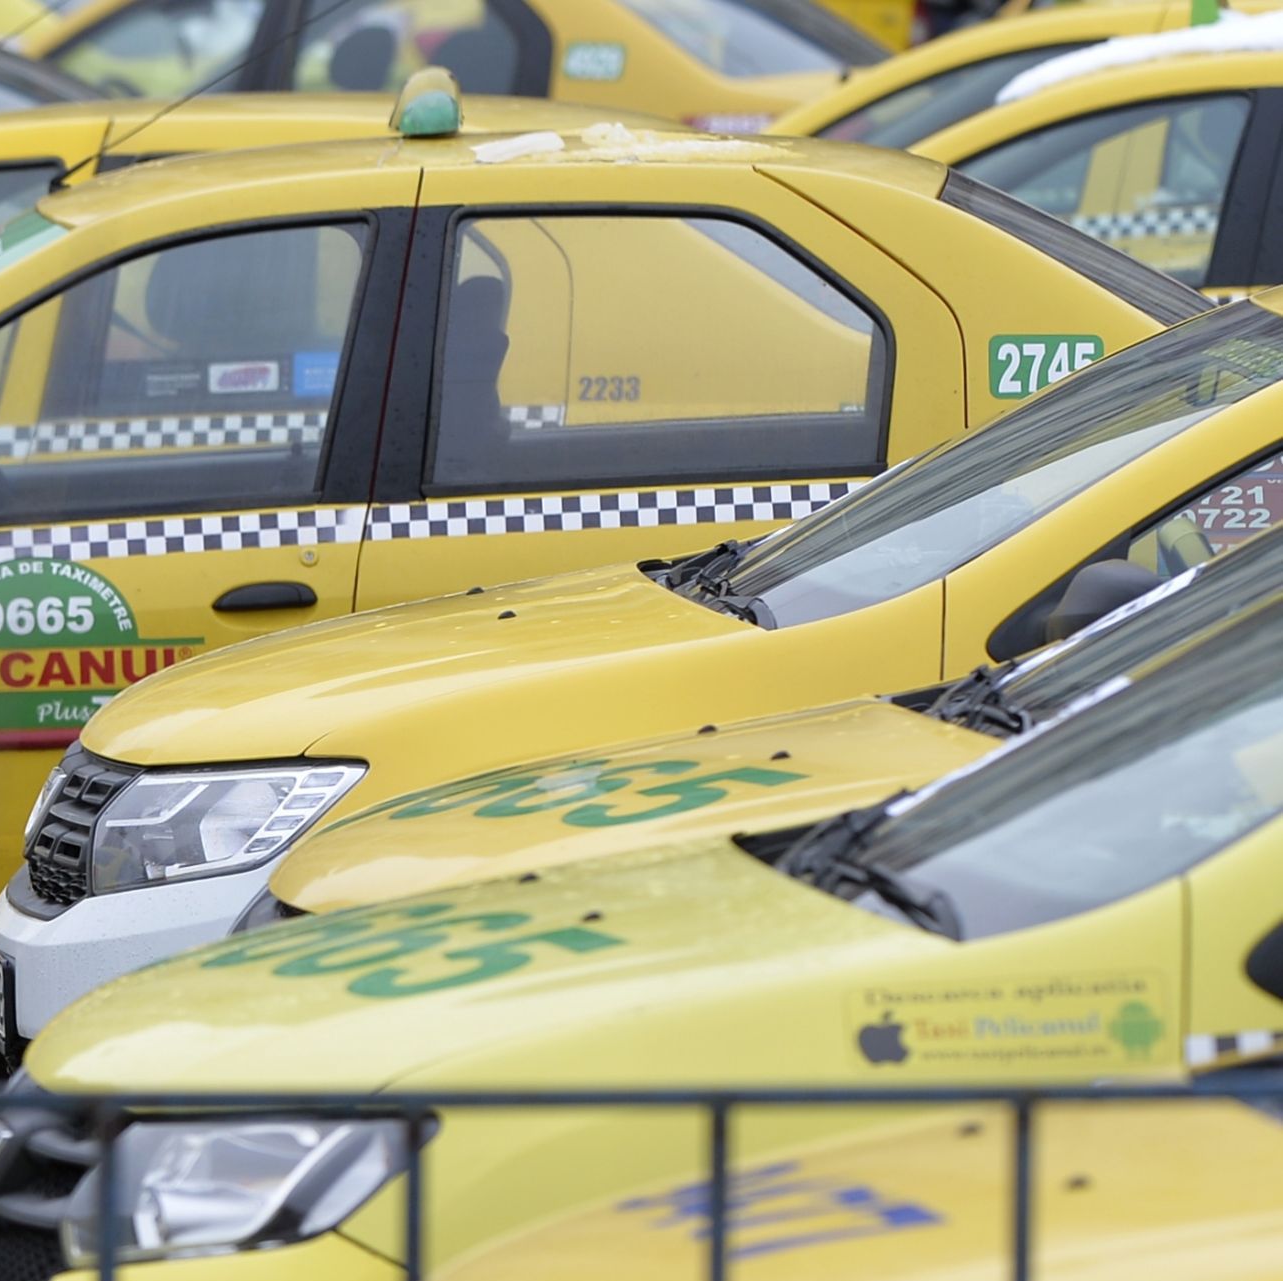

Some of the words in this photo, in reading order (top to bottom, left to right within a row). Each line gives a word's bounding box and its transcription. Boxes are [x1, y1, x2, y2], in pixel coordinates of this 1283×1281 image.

[578, 375, 641, 402] 2233
[1200, 486, 1265, 505] 21
[18, 561, 44, 575] DE
[50, 561, 134, 633] TAXIMETRE
[37, 700, 94, 724] Plus
